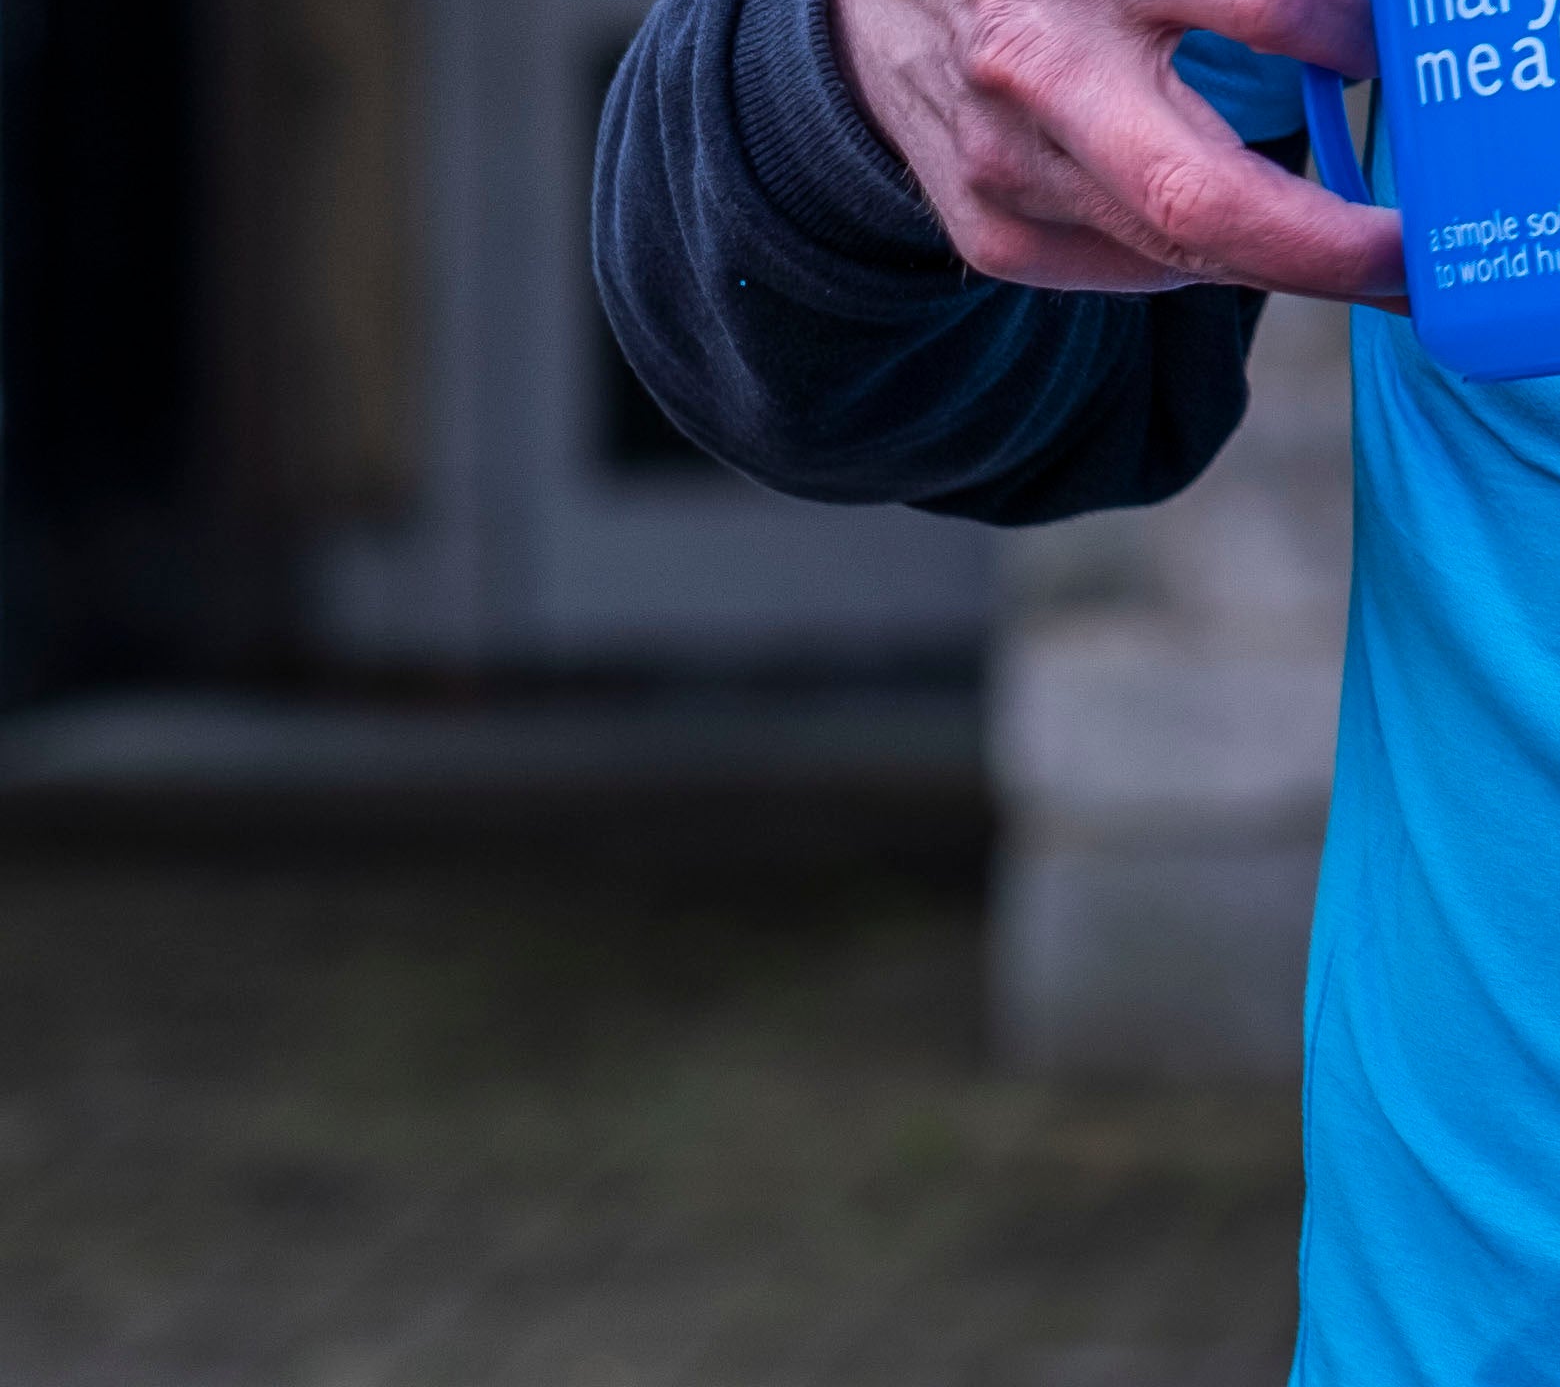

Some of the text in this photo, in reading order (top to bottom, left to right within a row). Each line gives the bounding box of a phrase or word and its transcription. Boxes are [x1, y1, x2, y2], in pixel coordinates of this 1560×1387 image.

[1429, 228, 1440, 252] a
[1442, 208, 1519, 252] simple
[1435, 261, 1455, 290] to
[1459, 243, 1529, 285] world
